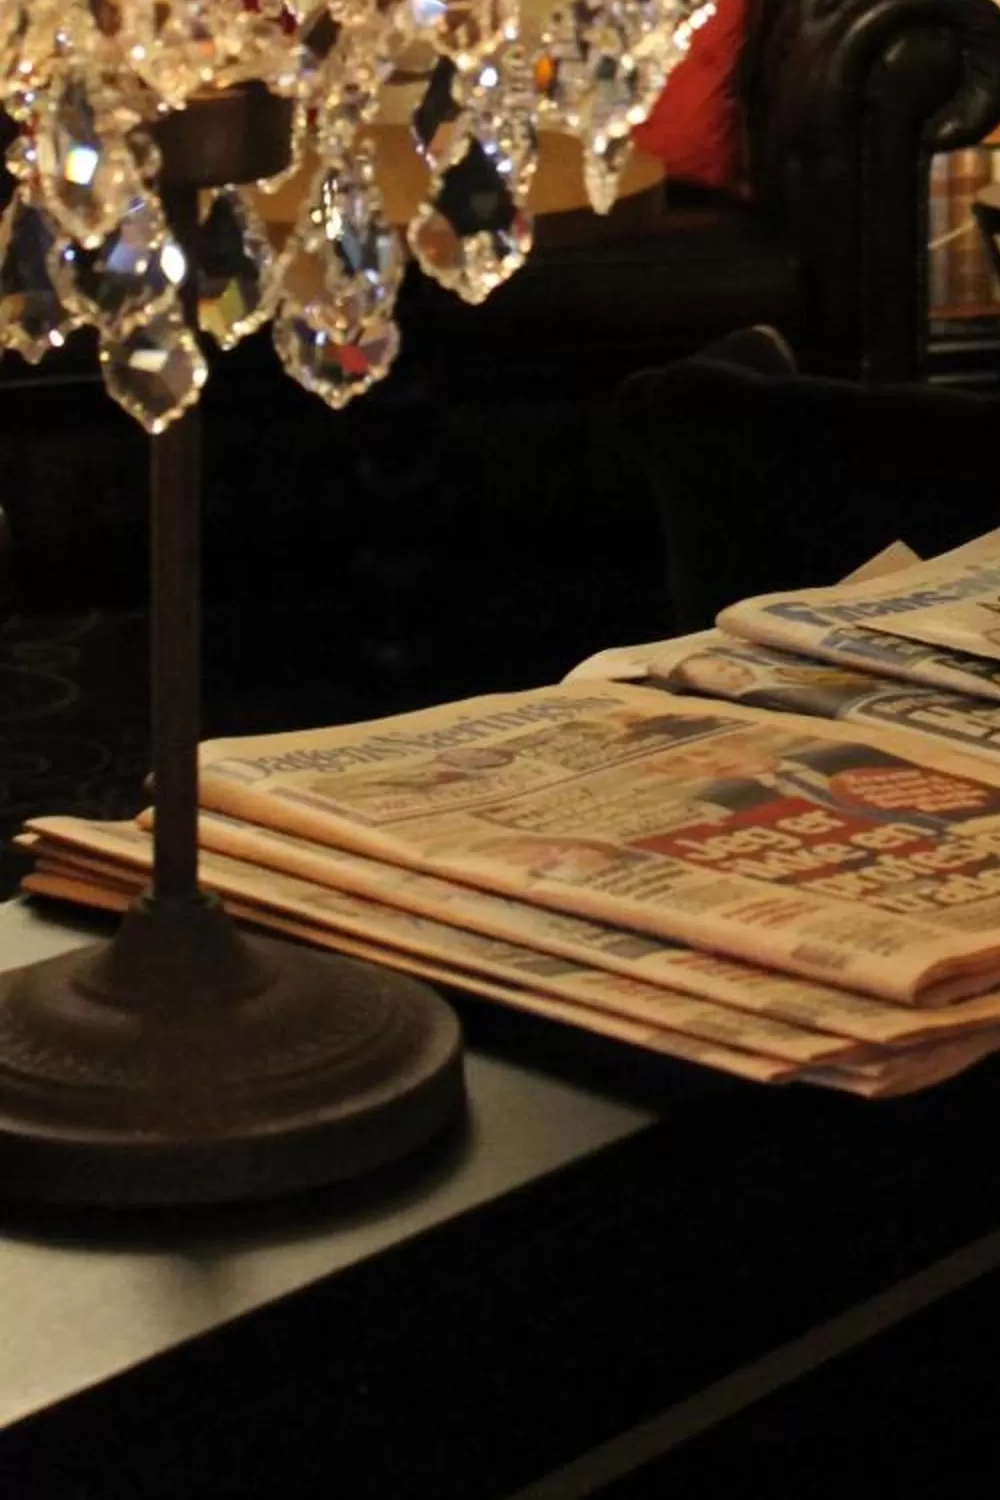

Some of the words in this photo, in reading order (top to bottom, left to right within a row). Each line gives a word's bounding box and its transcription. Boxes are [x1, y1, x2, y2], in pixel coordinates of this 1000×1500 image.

[674, 826, 803, 862] Jeg
[776, 809, 845, 835] er
[717, 842, 867, 881] ikke
[848, 821, 937, 850] en
